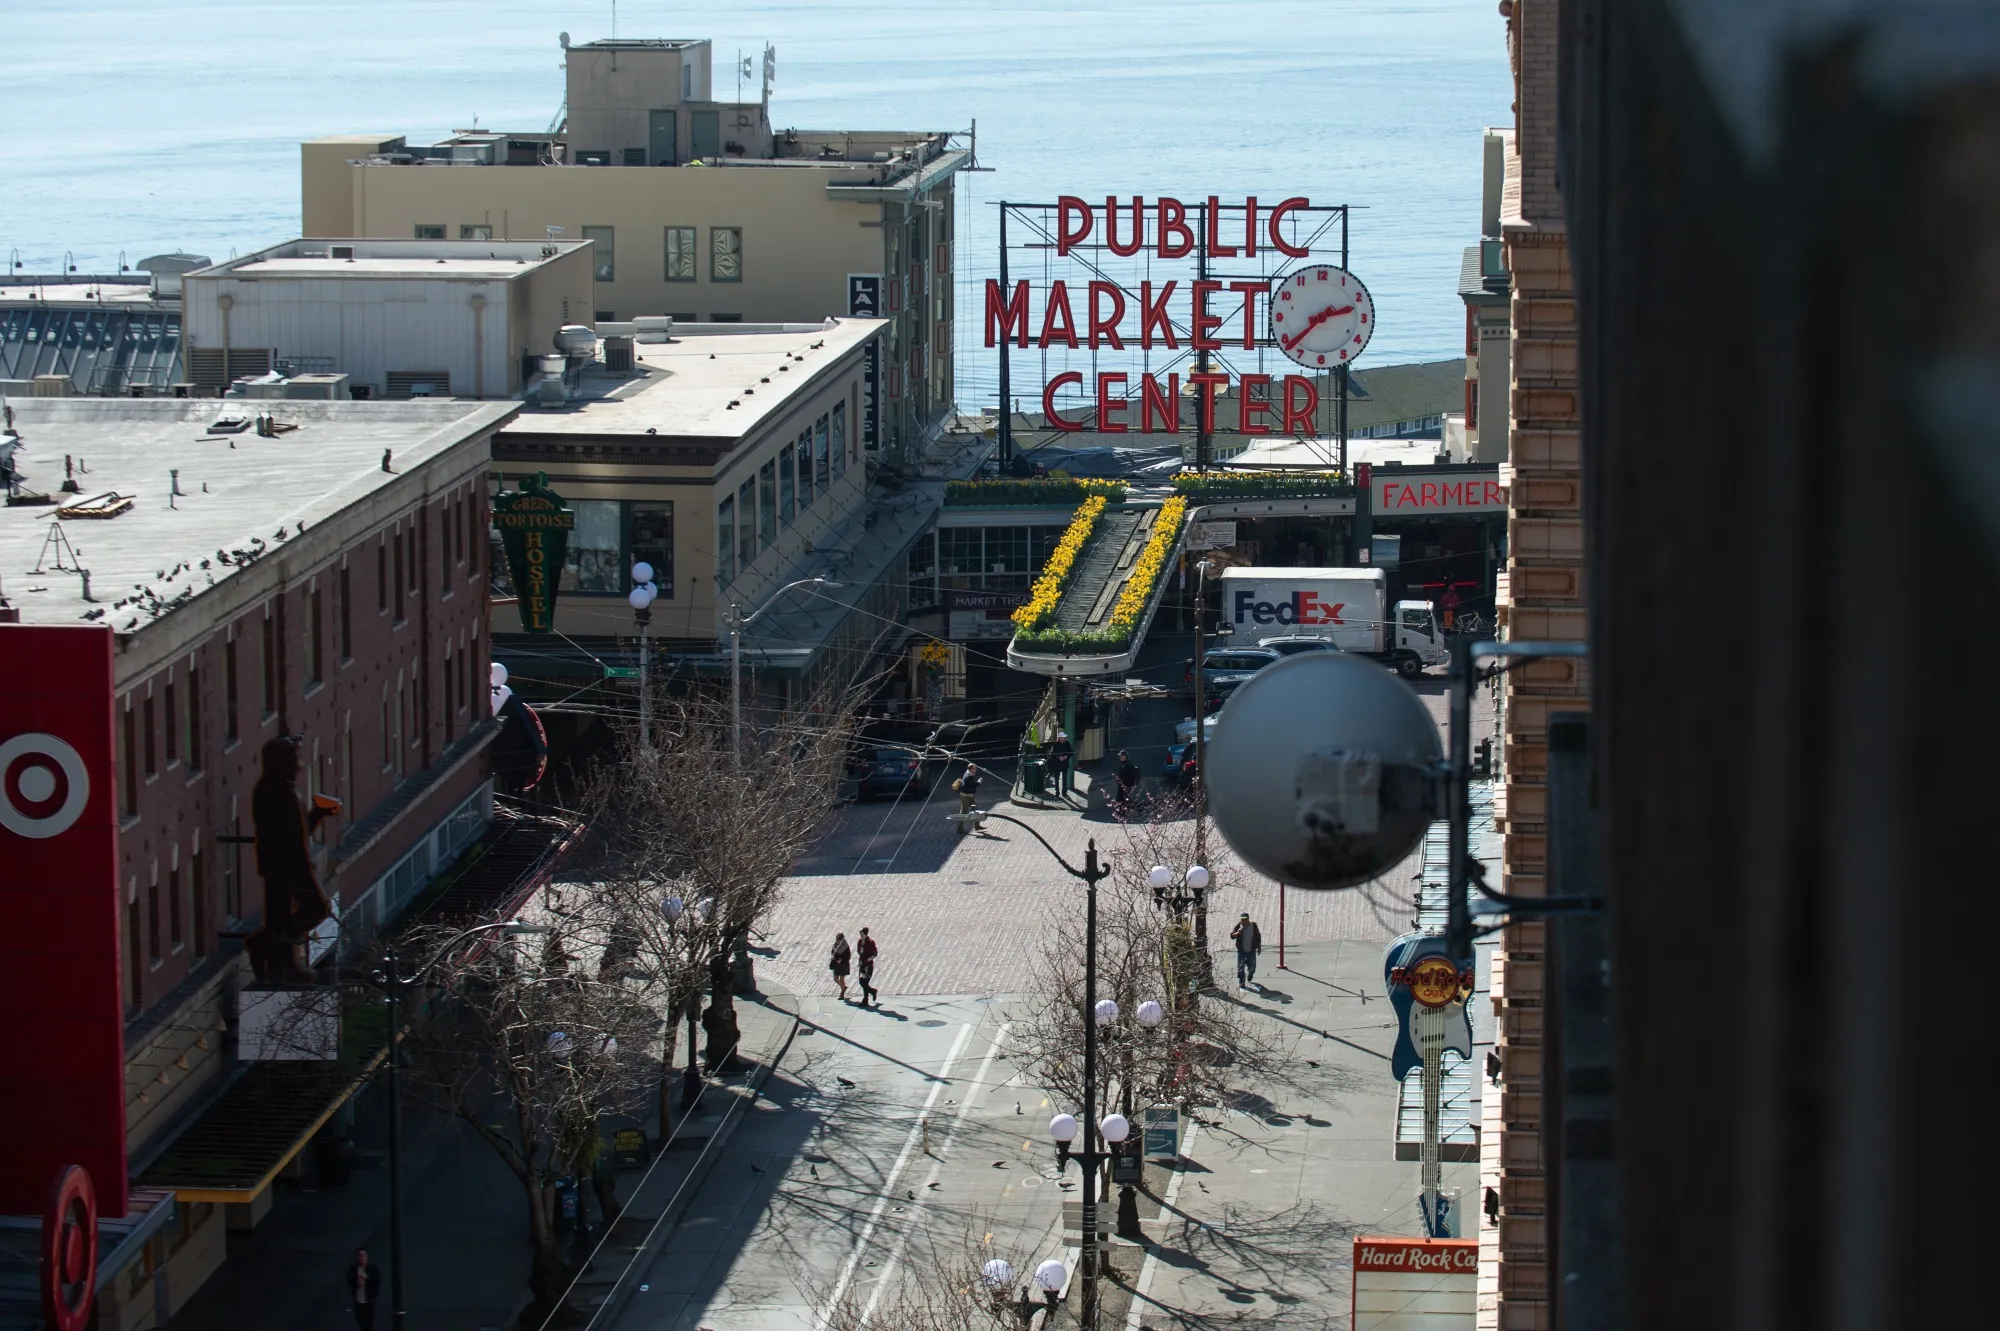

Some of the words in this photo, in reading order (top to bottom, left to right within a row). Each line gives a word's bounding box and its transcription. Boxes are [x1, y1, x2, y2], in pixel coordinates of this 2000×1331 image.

[1057, 195, 1309, 258] PUBLIC
[1297, 276, 1305, 286] 11
[1317, 271, 1329, 281] 12
[1341, 276, 1346, 287] 1
[1281, 291, 1292, 301] 10
[1355, 292, 1363, 302] 2
[984, 278, 1271, 351] MARKET
[1275, 312, 1284, 322] 9
[1360, 313, 1368, 324] 3
[1281, 333, 1289, 344] 8
[1353, 334, 1362, 344] 4
[1296, 349, 1304, 358] 7
[1340, 350, 1347, 359] 5
[1317, 355, 1325, 365] 6
[1042, 371, 1318, 437] CENTER
[512, 497, 555, 511] GREEN
[496, 513, 573, 527] TORTOISE
[524, 532, 546, 629] HOSTEL
[955, 596, 998, 606] MARKET
[1234, 590, 1346, 625] FedEx
[1390, 966, 1435, 986] Hard
[1435, 967, 1474, 990] Rock
[1359, 1247, 1407, 1266] Hard
[1407, 1248, 1452, 1270] Rock
